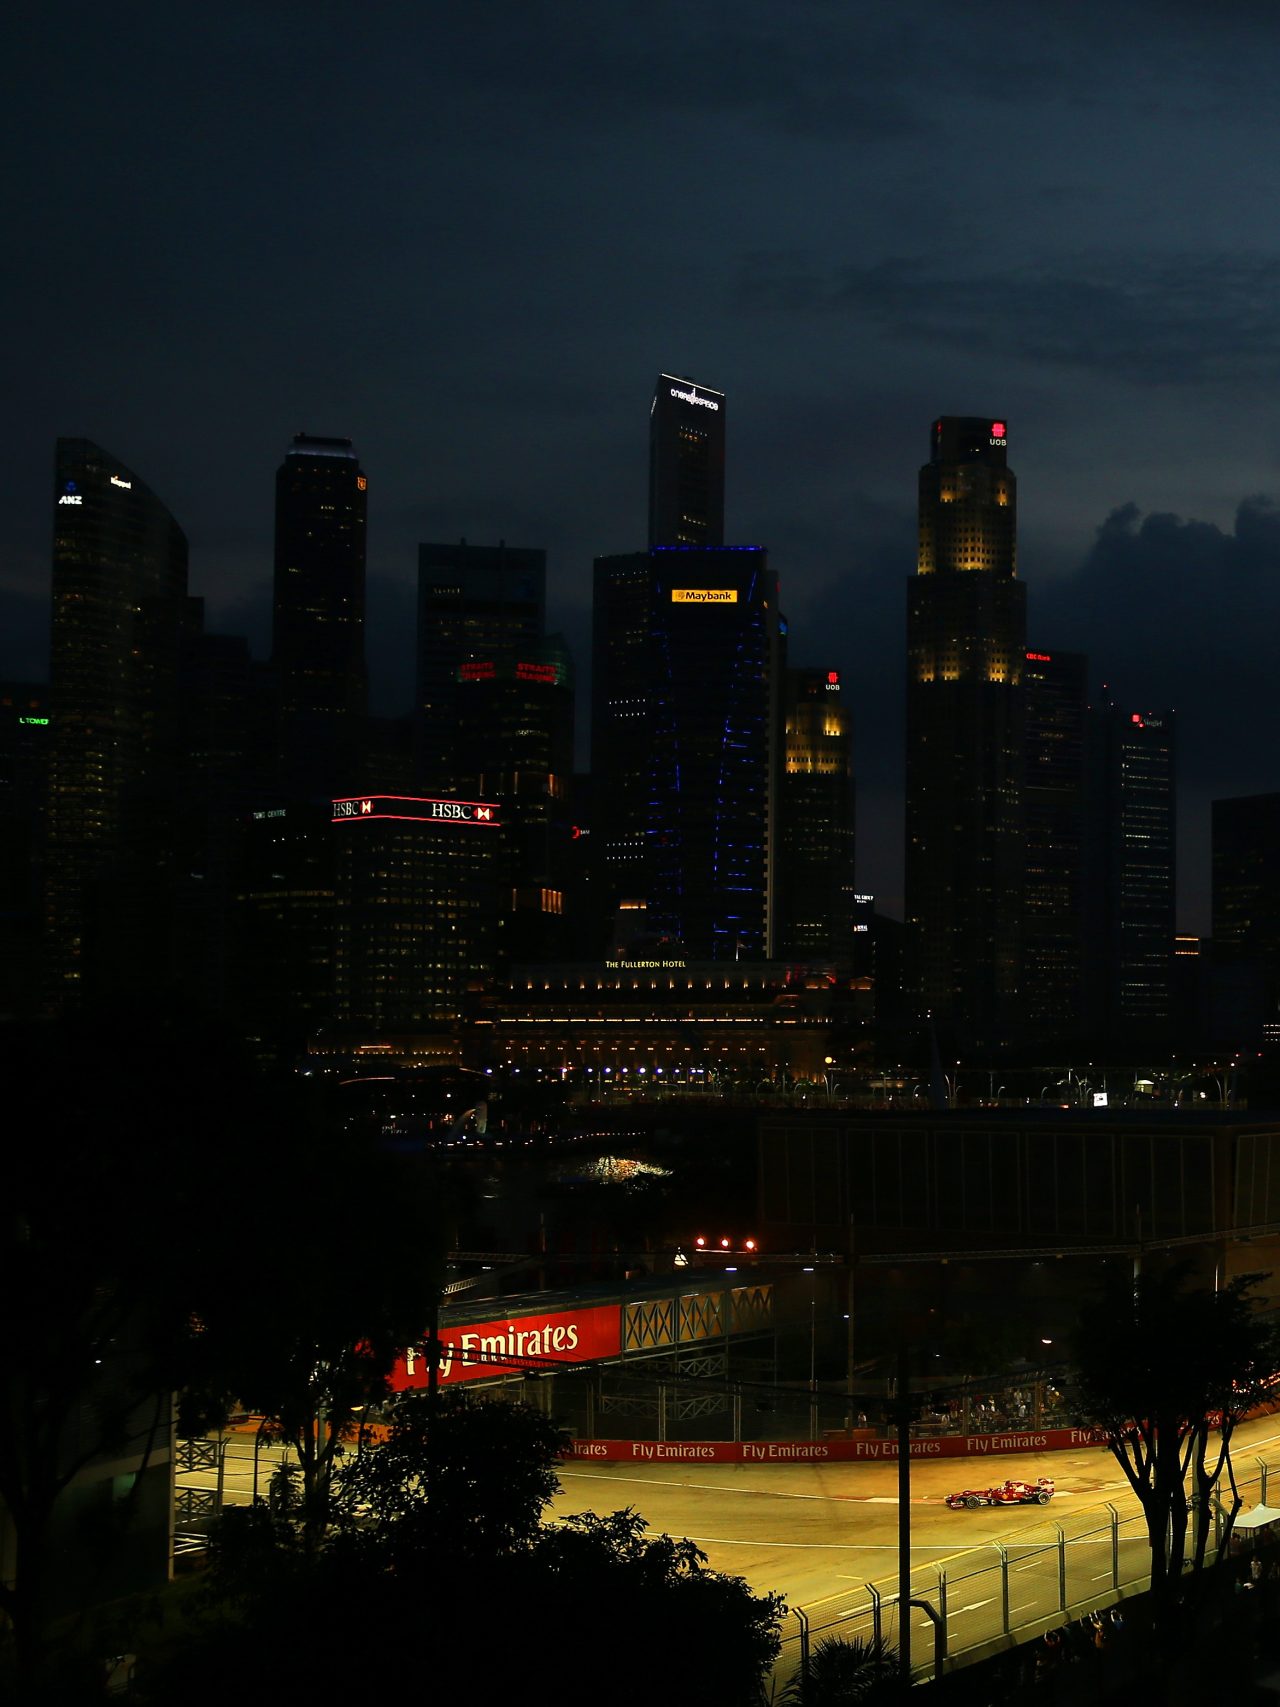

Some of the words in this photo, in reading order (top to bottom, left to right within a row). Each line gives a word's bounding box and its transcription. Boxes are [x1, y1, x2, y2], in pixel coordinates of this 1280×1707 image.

[989, 438, 1007, 446] UOB
[58, 495, 82, 504] ANZ
[685, 591, 732, 601] Maybank
[333, 801, 359, 817] HSBC
[431, 803, 472, 819] HSBC
[605, 960, 619, 968] THE
[620, 960, 660, 968] FULLERTON
[662, 960, 686, 968] HOTEL
[406, 1343, 455, 1378] Fy
[461, 1322, 579, 1367] Emirates
[553, 1441, 608, 1456] irates
[856, 1442, 879, 1457] Fly
[882, 1442, 941, 1455] Emrates
[967, 1438, 989, 1452] Fly
[991, 1434, 1047, 1449] Emirates
[632, 1443, 654, 1459] Fly
[656, 1444, 715, 1457] Emirates
[742, 1444, 766, 1460] Fly
[768, 1443, 829, 1457] Emirates
